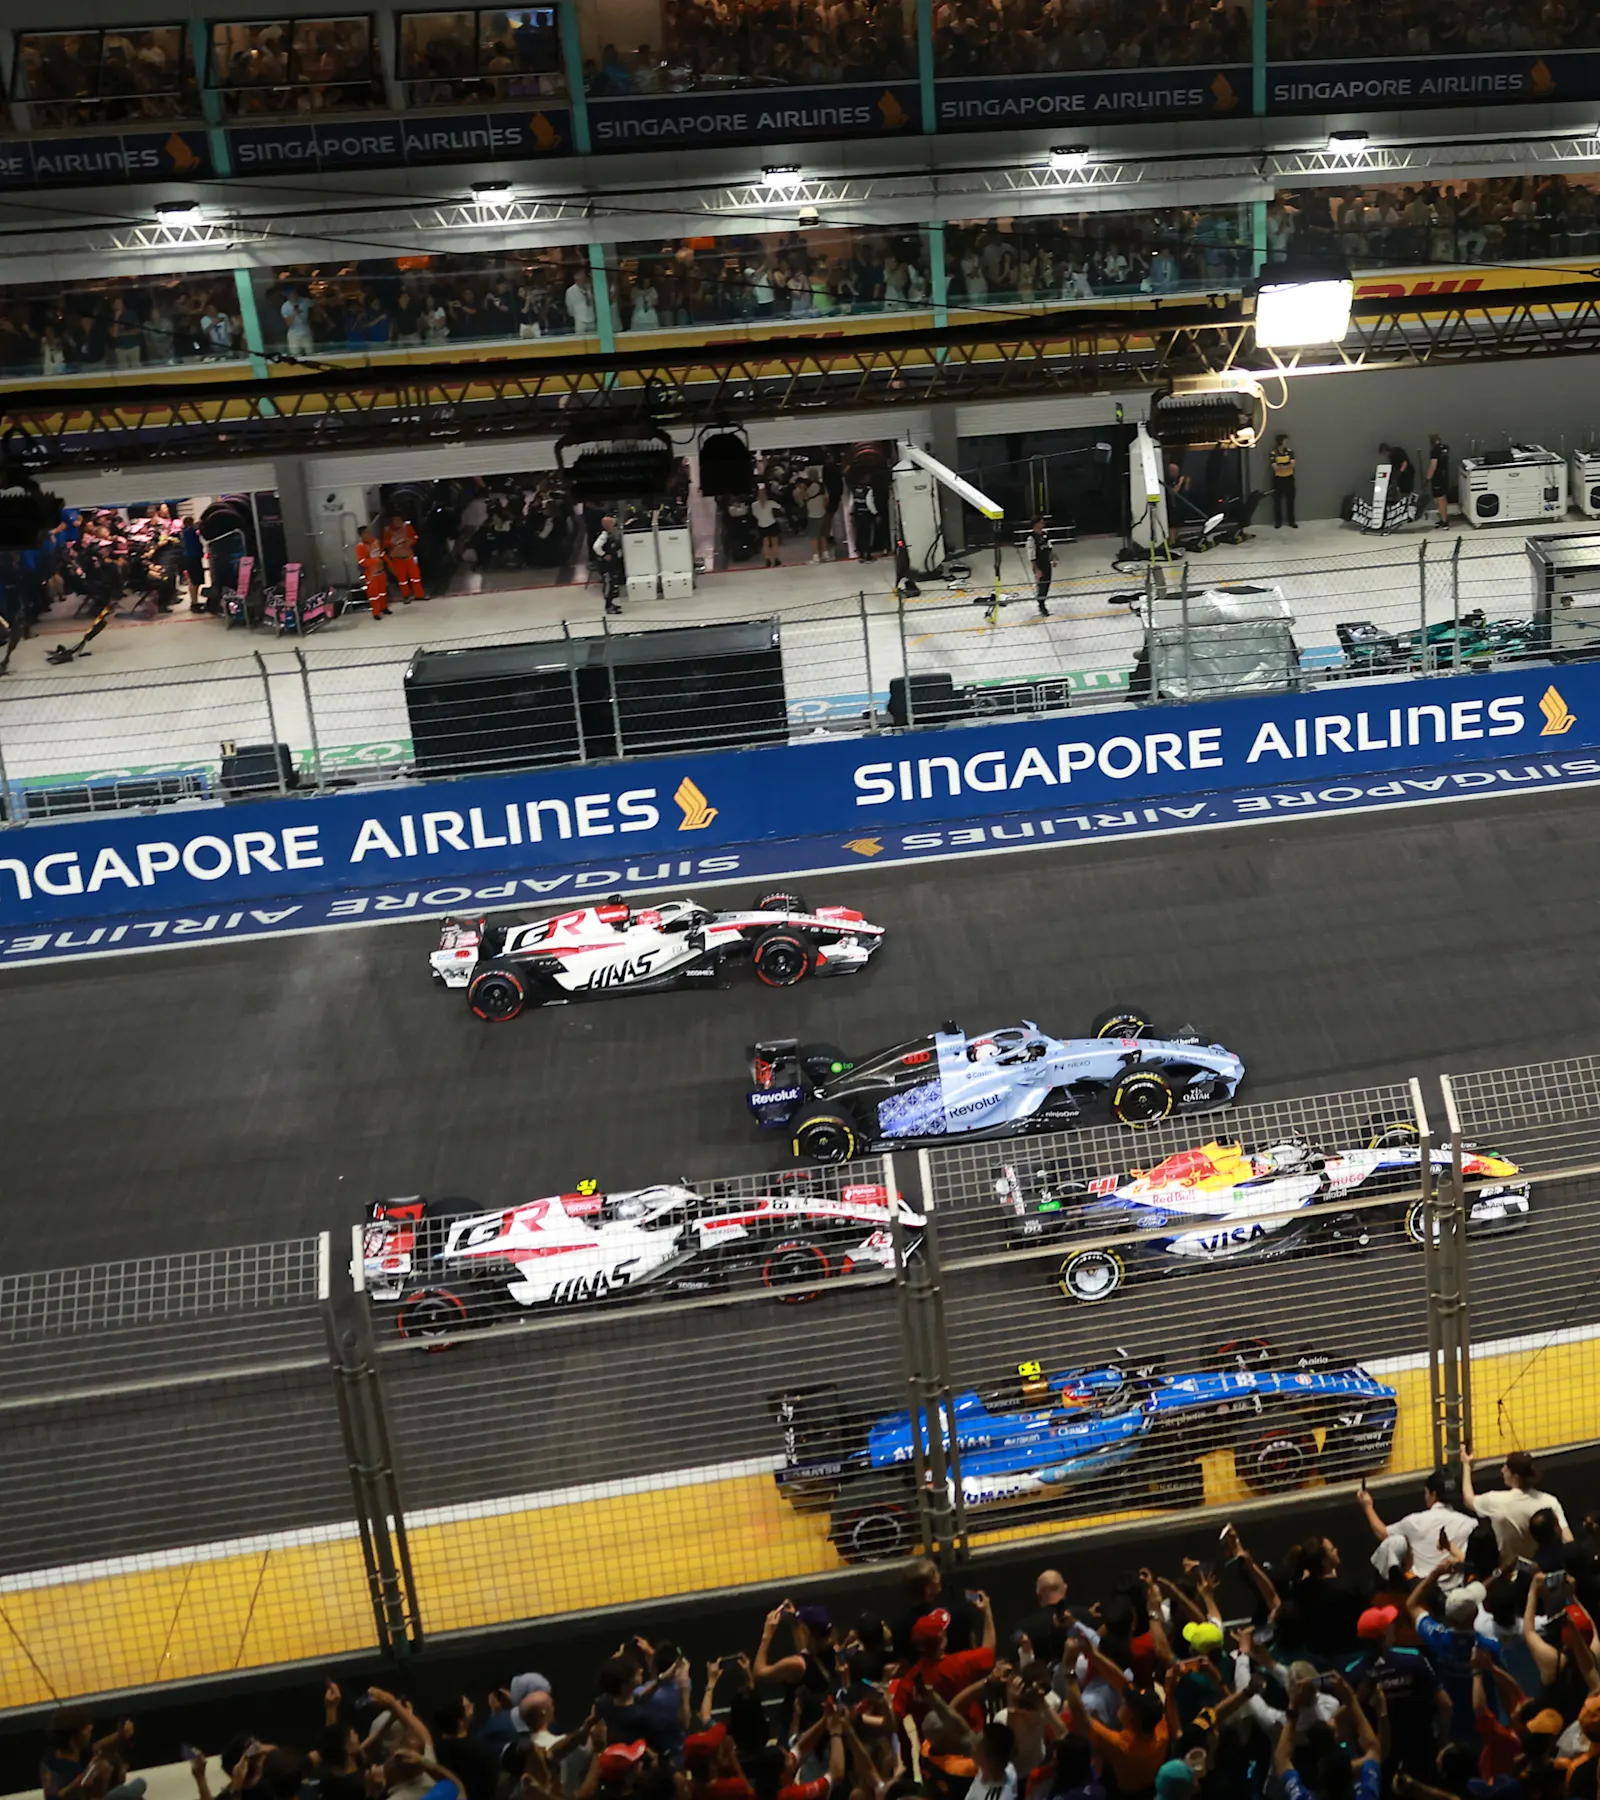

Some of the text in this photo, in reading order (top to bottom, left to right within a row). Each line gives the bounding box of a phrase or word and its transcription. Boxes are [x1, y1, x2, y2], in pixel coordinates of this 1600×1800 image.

[942, 88, 1203, 118] SINGAPORE AIRLINES
[1274, 73, 1523, 101] SINGAPORE AIRLINES
[597, 106, 871, 139] SINGAPORE AIRLINES
[238, 126, 523, 162] SINGAPORE AIRLINES
[36, 149, 160, 174] AIRLINES
[852, 695, 1526, 807] SINGAPORE AIRLINES
[350, 787, 660, 863] AIRLINES
[901, 801, 1205, 852] AIRLINES
[328, 854, 742, 917] SINGAPORE
[574, 949, 661, 992] HAAS
[751, 1088, 800, 1105] Revolut
[949, 1093, 1001, 1119] Revolut
[1153, 1193, 1174, 1204] Red
[1199, 1222, 1268, 1253] VISA
